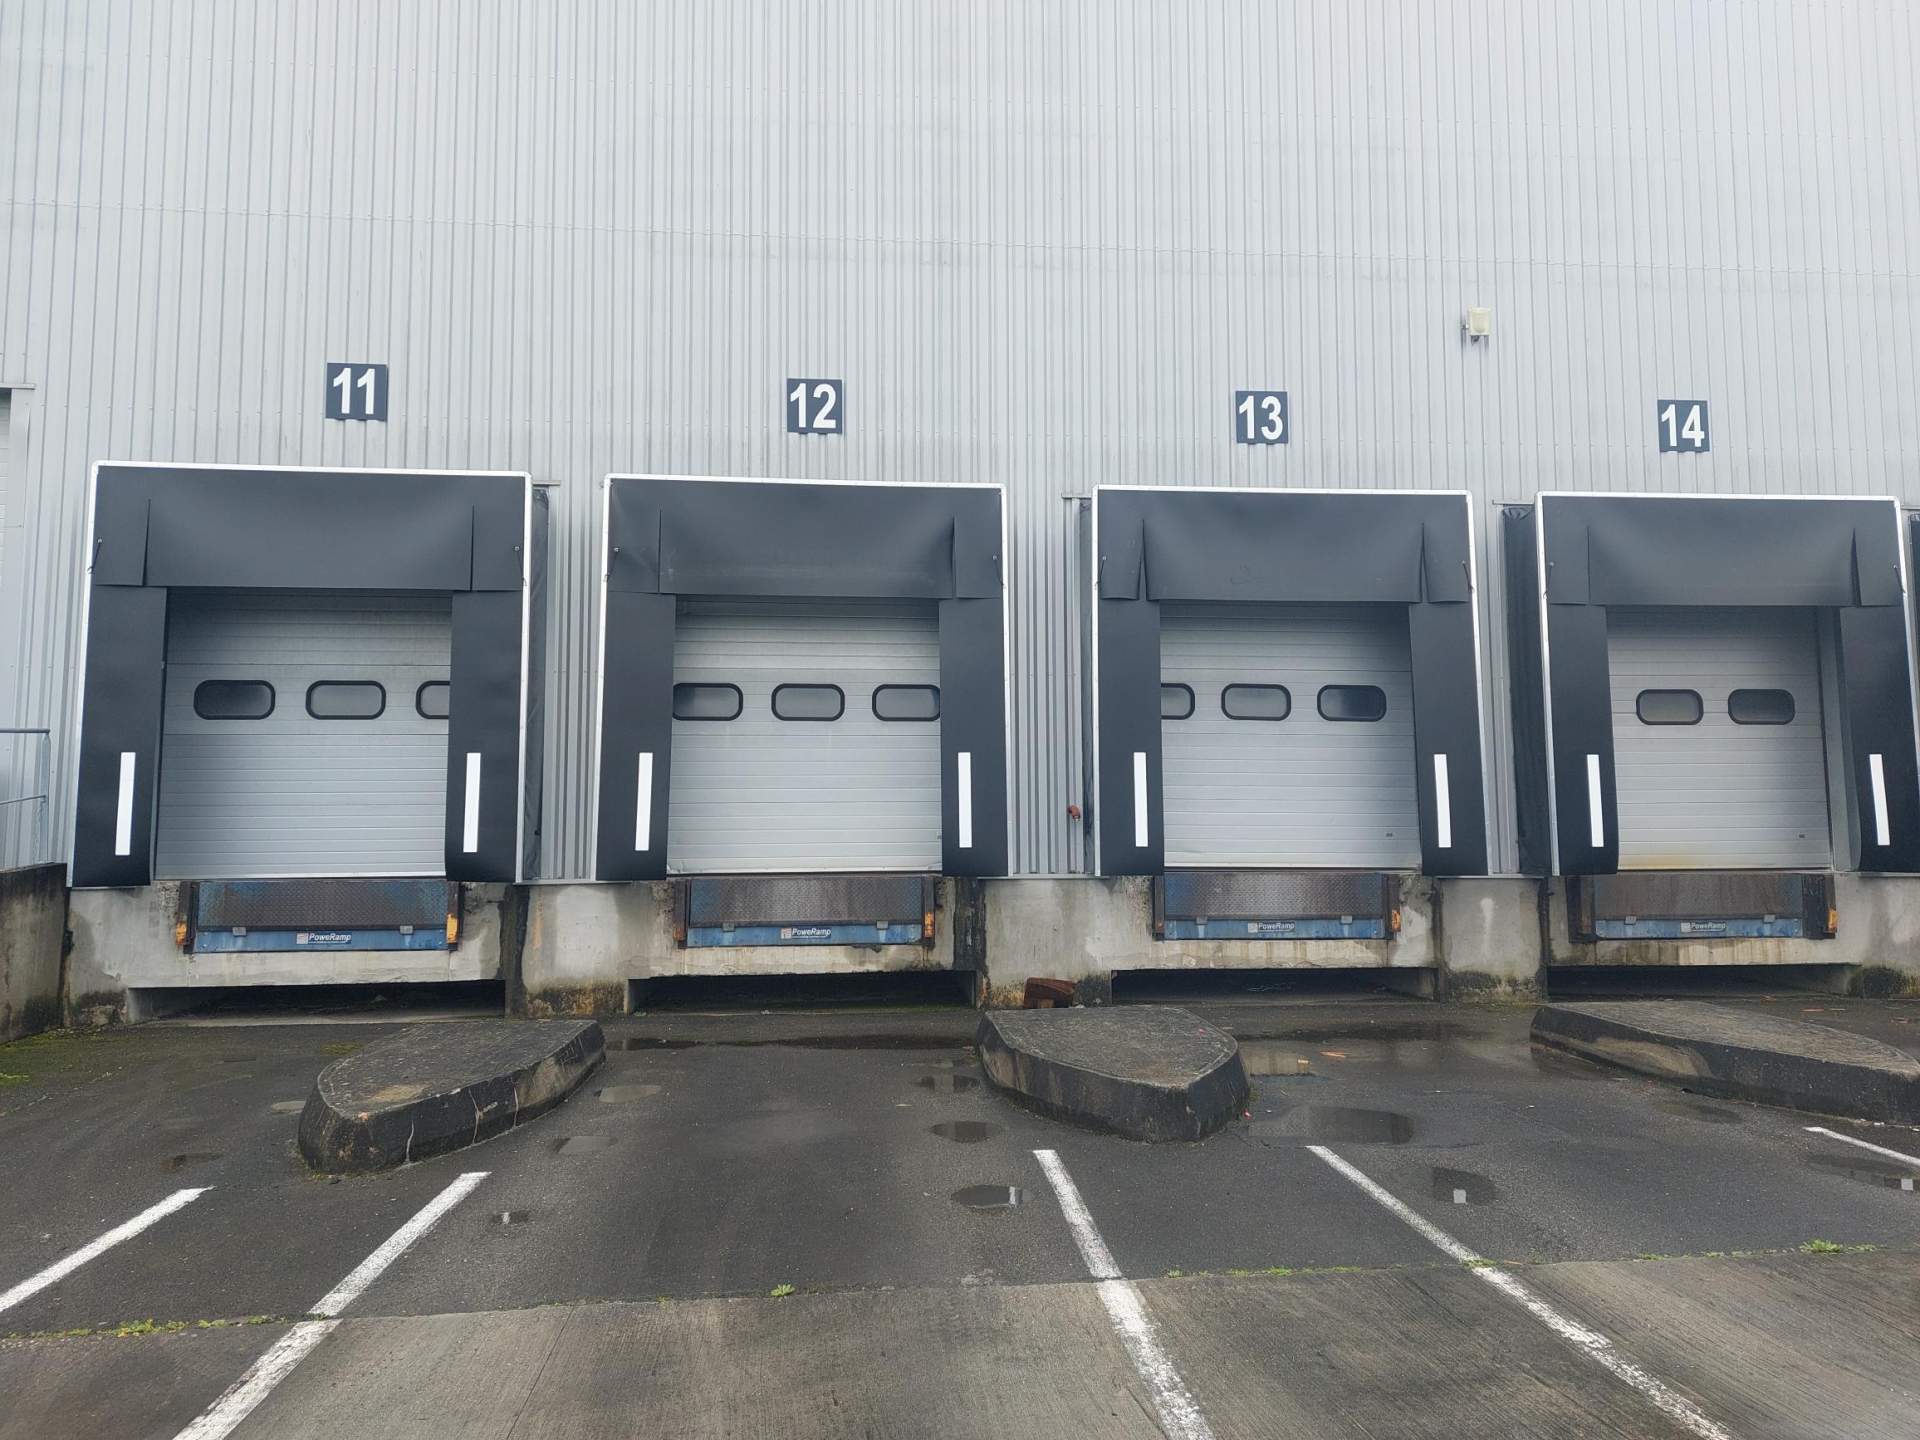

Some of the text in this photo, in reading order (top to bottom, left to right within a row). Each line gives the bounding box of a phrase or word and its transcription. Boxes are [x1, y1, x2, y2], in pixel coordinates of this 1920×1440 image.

[333, 367, 375, 415] 11
[790, 382, 836, 429] 12
[1239, 395, 1283, 440] 13
[1661, 404, 1705, 448] 14
[308, 932, 352, 942] PoweRamp
[791, 927, 832, 937] PoweRamp
